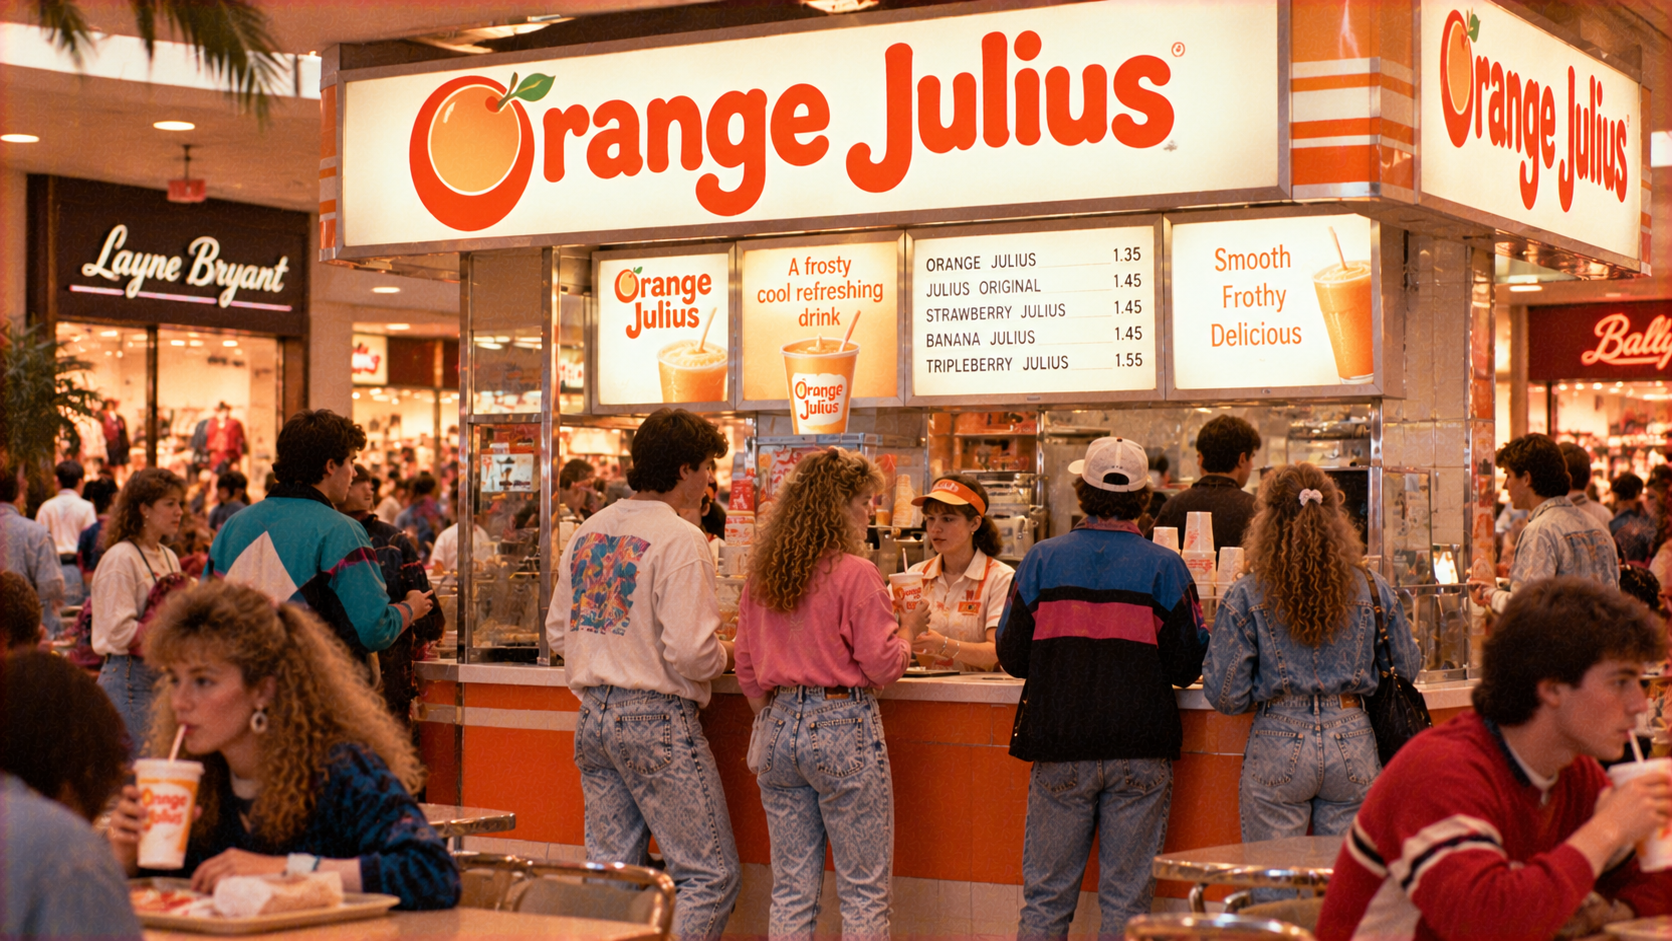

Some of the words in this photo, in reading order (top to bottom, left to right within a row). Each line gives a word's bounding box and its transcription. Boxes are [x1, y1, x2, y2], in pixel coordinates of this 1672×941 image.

[1440, 9, 1556, 211] Orange
[1558, 65, 1628, 213] Julius
[409, 73, 829, 232] Orange
[847, 30, 1175, 193] Julius
[81, 224, 182, 299] Layne
[187, 236, 289, 308] Bryant
[788, 258, 799, 277] A
[805, 256, 852, 278] frosty
[927, 256, 981, 272] ORANGE
[991, 253, 1036, 269] JULIUS
[1114, 247, 1141, 262] 1.35
[1214, 244, 1291, 272] Smooth
[614, 267, 712, 305] Orange
[757, 284, 791, 304] cool
[796, 280, 884, 303] refreshing
[926, 282, 970, 298] JULIUS
[979, 279, 1041, 295] ORIGINAL
[1114, 274, 1142, 288] 1.45
[1222, 283, 1287, 313] Frothy
[625, 300, 700, 340] Julius
[798, 307, 841, 327] drink
[926, 306, 1012, 323] STRAWBERRY
[1021, 304, 1066, 319] JULIUS
[1114, 300, 1142, 314] 1.45
[926, 332, 981, 348] BANANA
[990, 331, 1035, 346] JULIUS
[1115, 326, 1143, 341] 1.45
[1211, 322, 1302, 348] Delicious
[926, 358, 1013, 373] TRIPLEBERRY
[1023, 356, 1069, 371] JULIUS
[1115, 353, 1143, 367] 1.55
[794, 379, 843, 404] Orange
[800, 398, 839, 420] Julius
